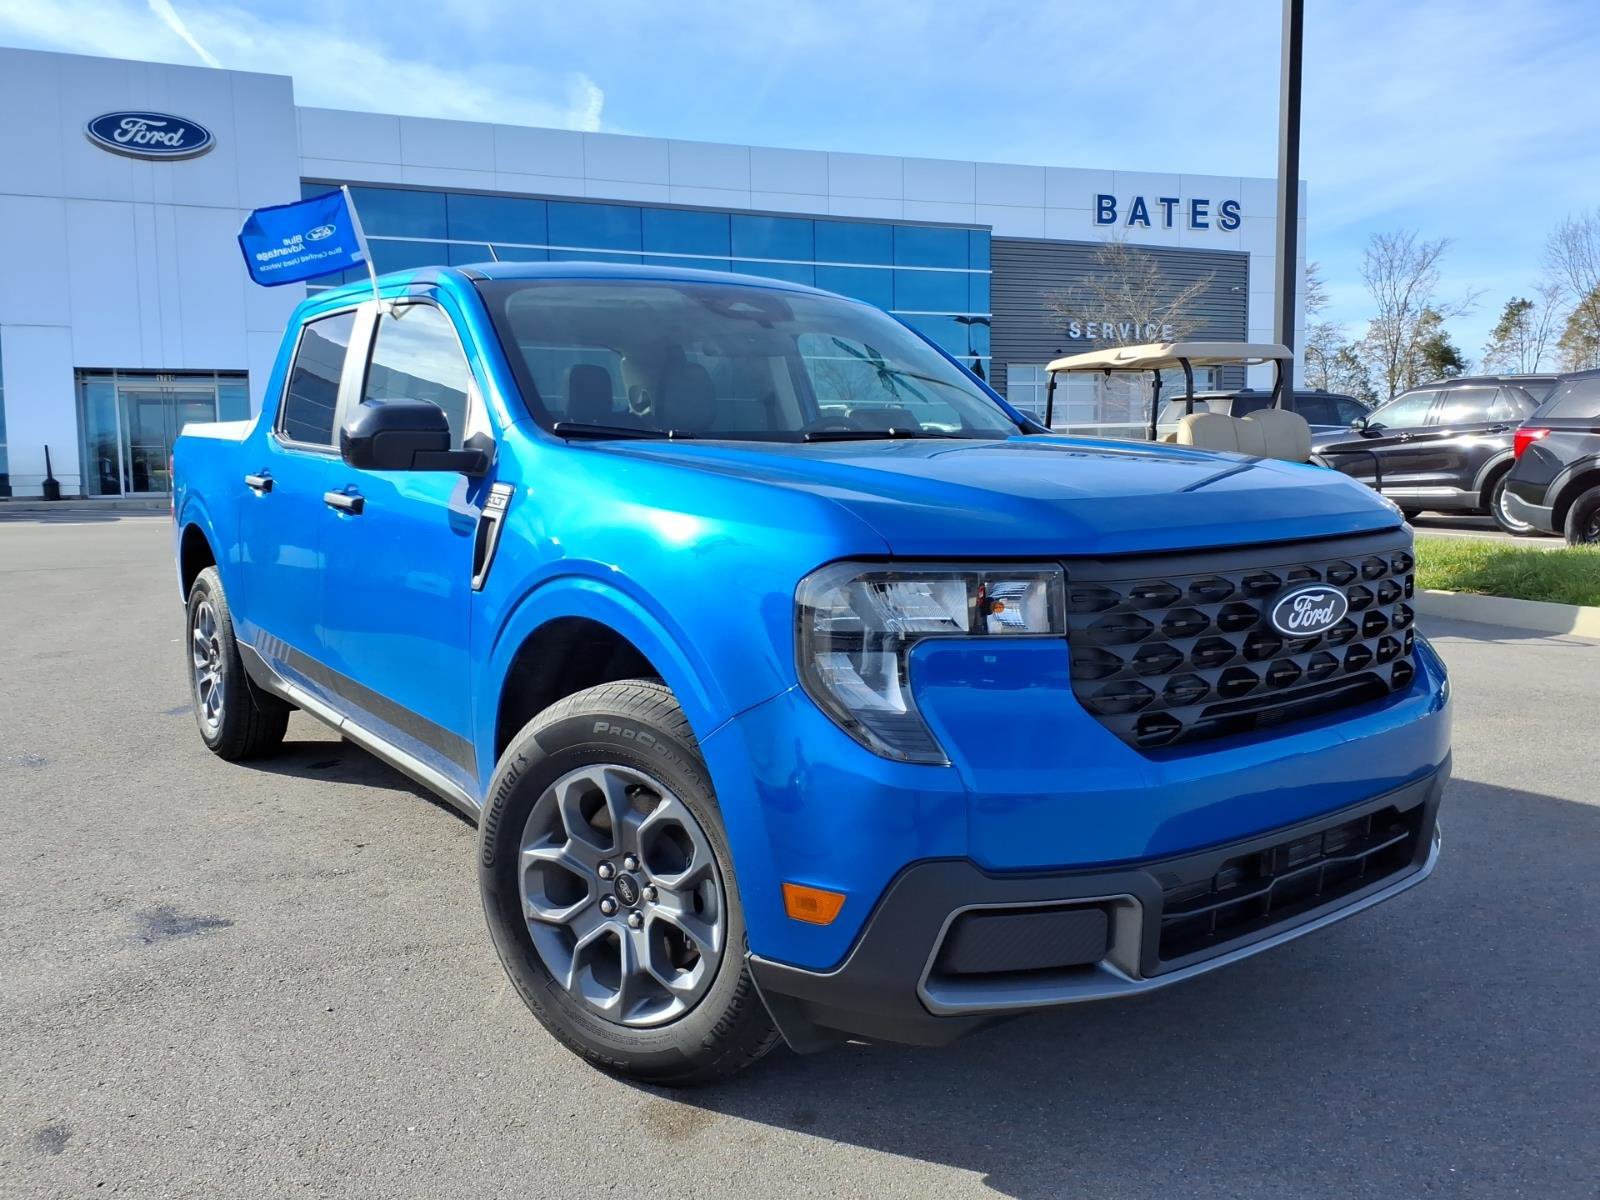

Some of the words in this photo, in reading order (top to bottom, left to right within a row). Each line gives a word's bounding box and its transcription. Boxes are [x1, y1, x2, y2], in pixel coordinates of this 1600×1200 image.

[113, 117, 185, 146] Ford
[1095, 194, 1242, 231] BATES
[1068, 320, 1175, 341] SERVICE
[1289, 594, 1336, 629] Ford
[482, 762, 522, 869] Continental
